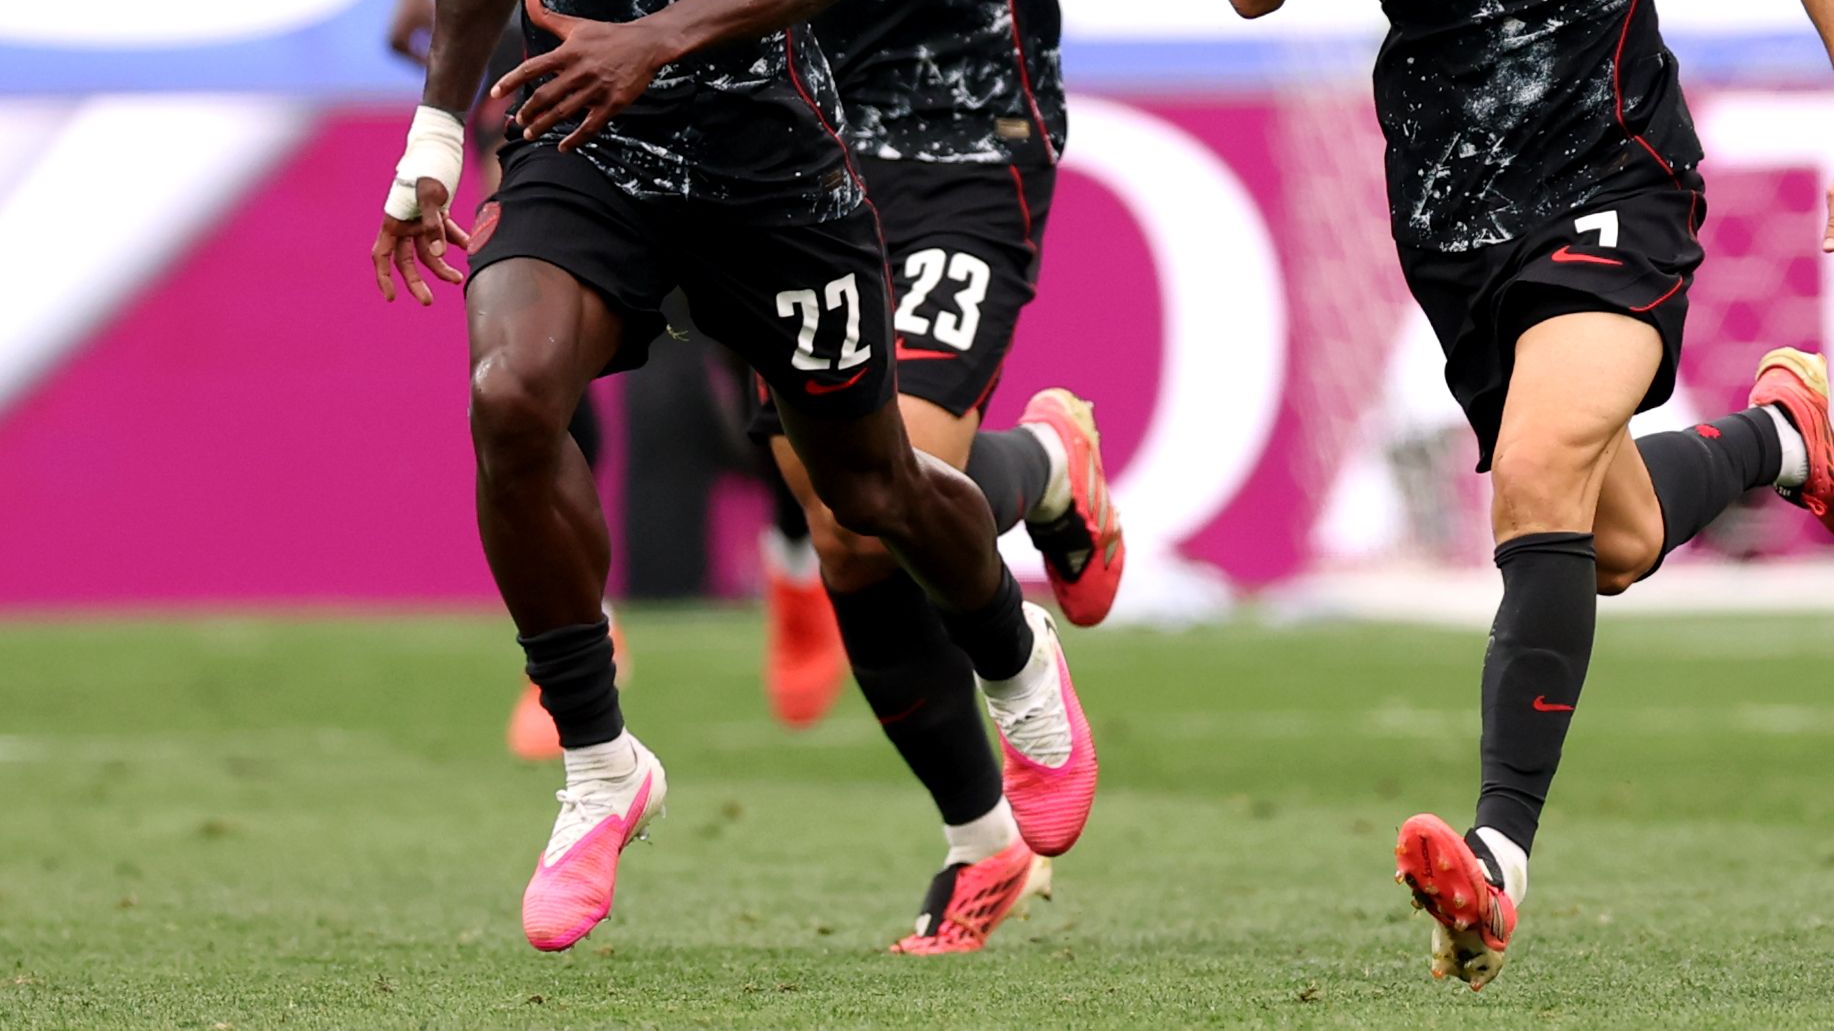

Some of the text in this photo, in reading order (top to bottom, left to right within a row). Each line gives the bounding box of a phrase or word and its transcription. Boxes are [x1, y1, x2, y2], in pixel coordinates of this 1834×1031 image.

[1574, 209, 1619, 248] 7
[776, 272, 872, 371] 22
[894, 247, 990, 351] 23
